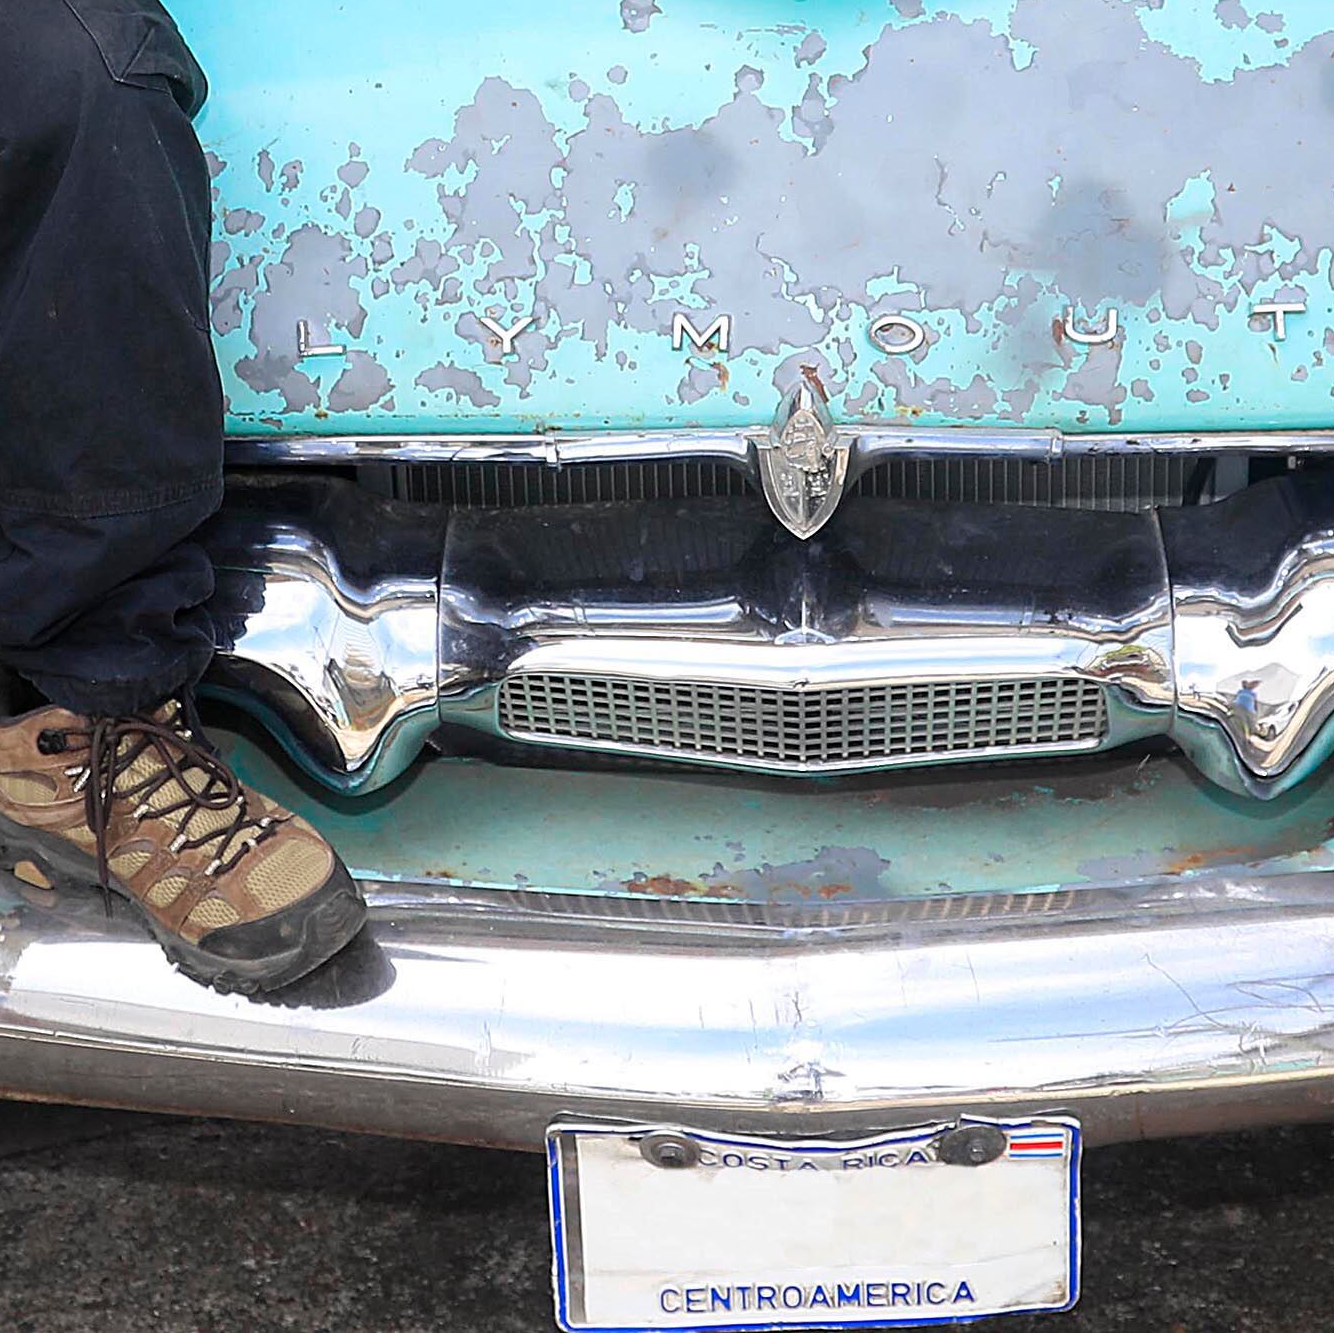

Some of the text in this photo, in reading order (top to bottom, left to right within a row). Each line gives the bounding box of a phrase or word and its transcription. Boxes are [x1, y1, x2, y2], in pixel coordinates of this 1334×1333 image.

[698, 1148, 930, 1171] COSTA RICA
[660, 1281, 976, 1313] CENTROAMERICA
